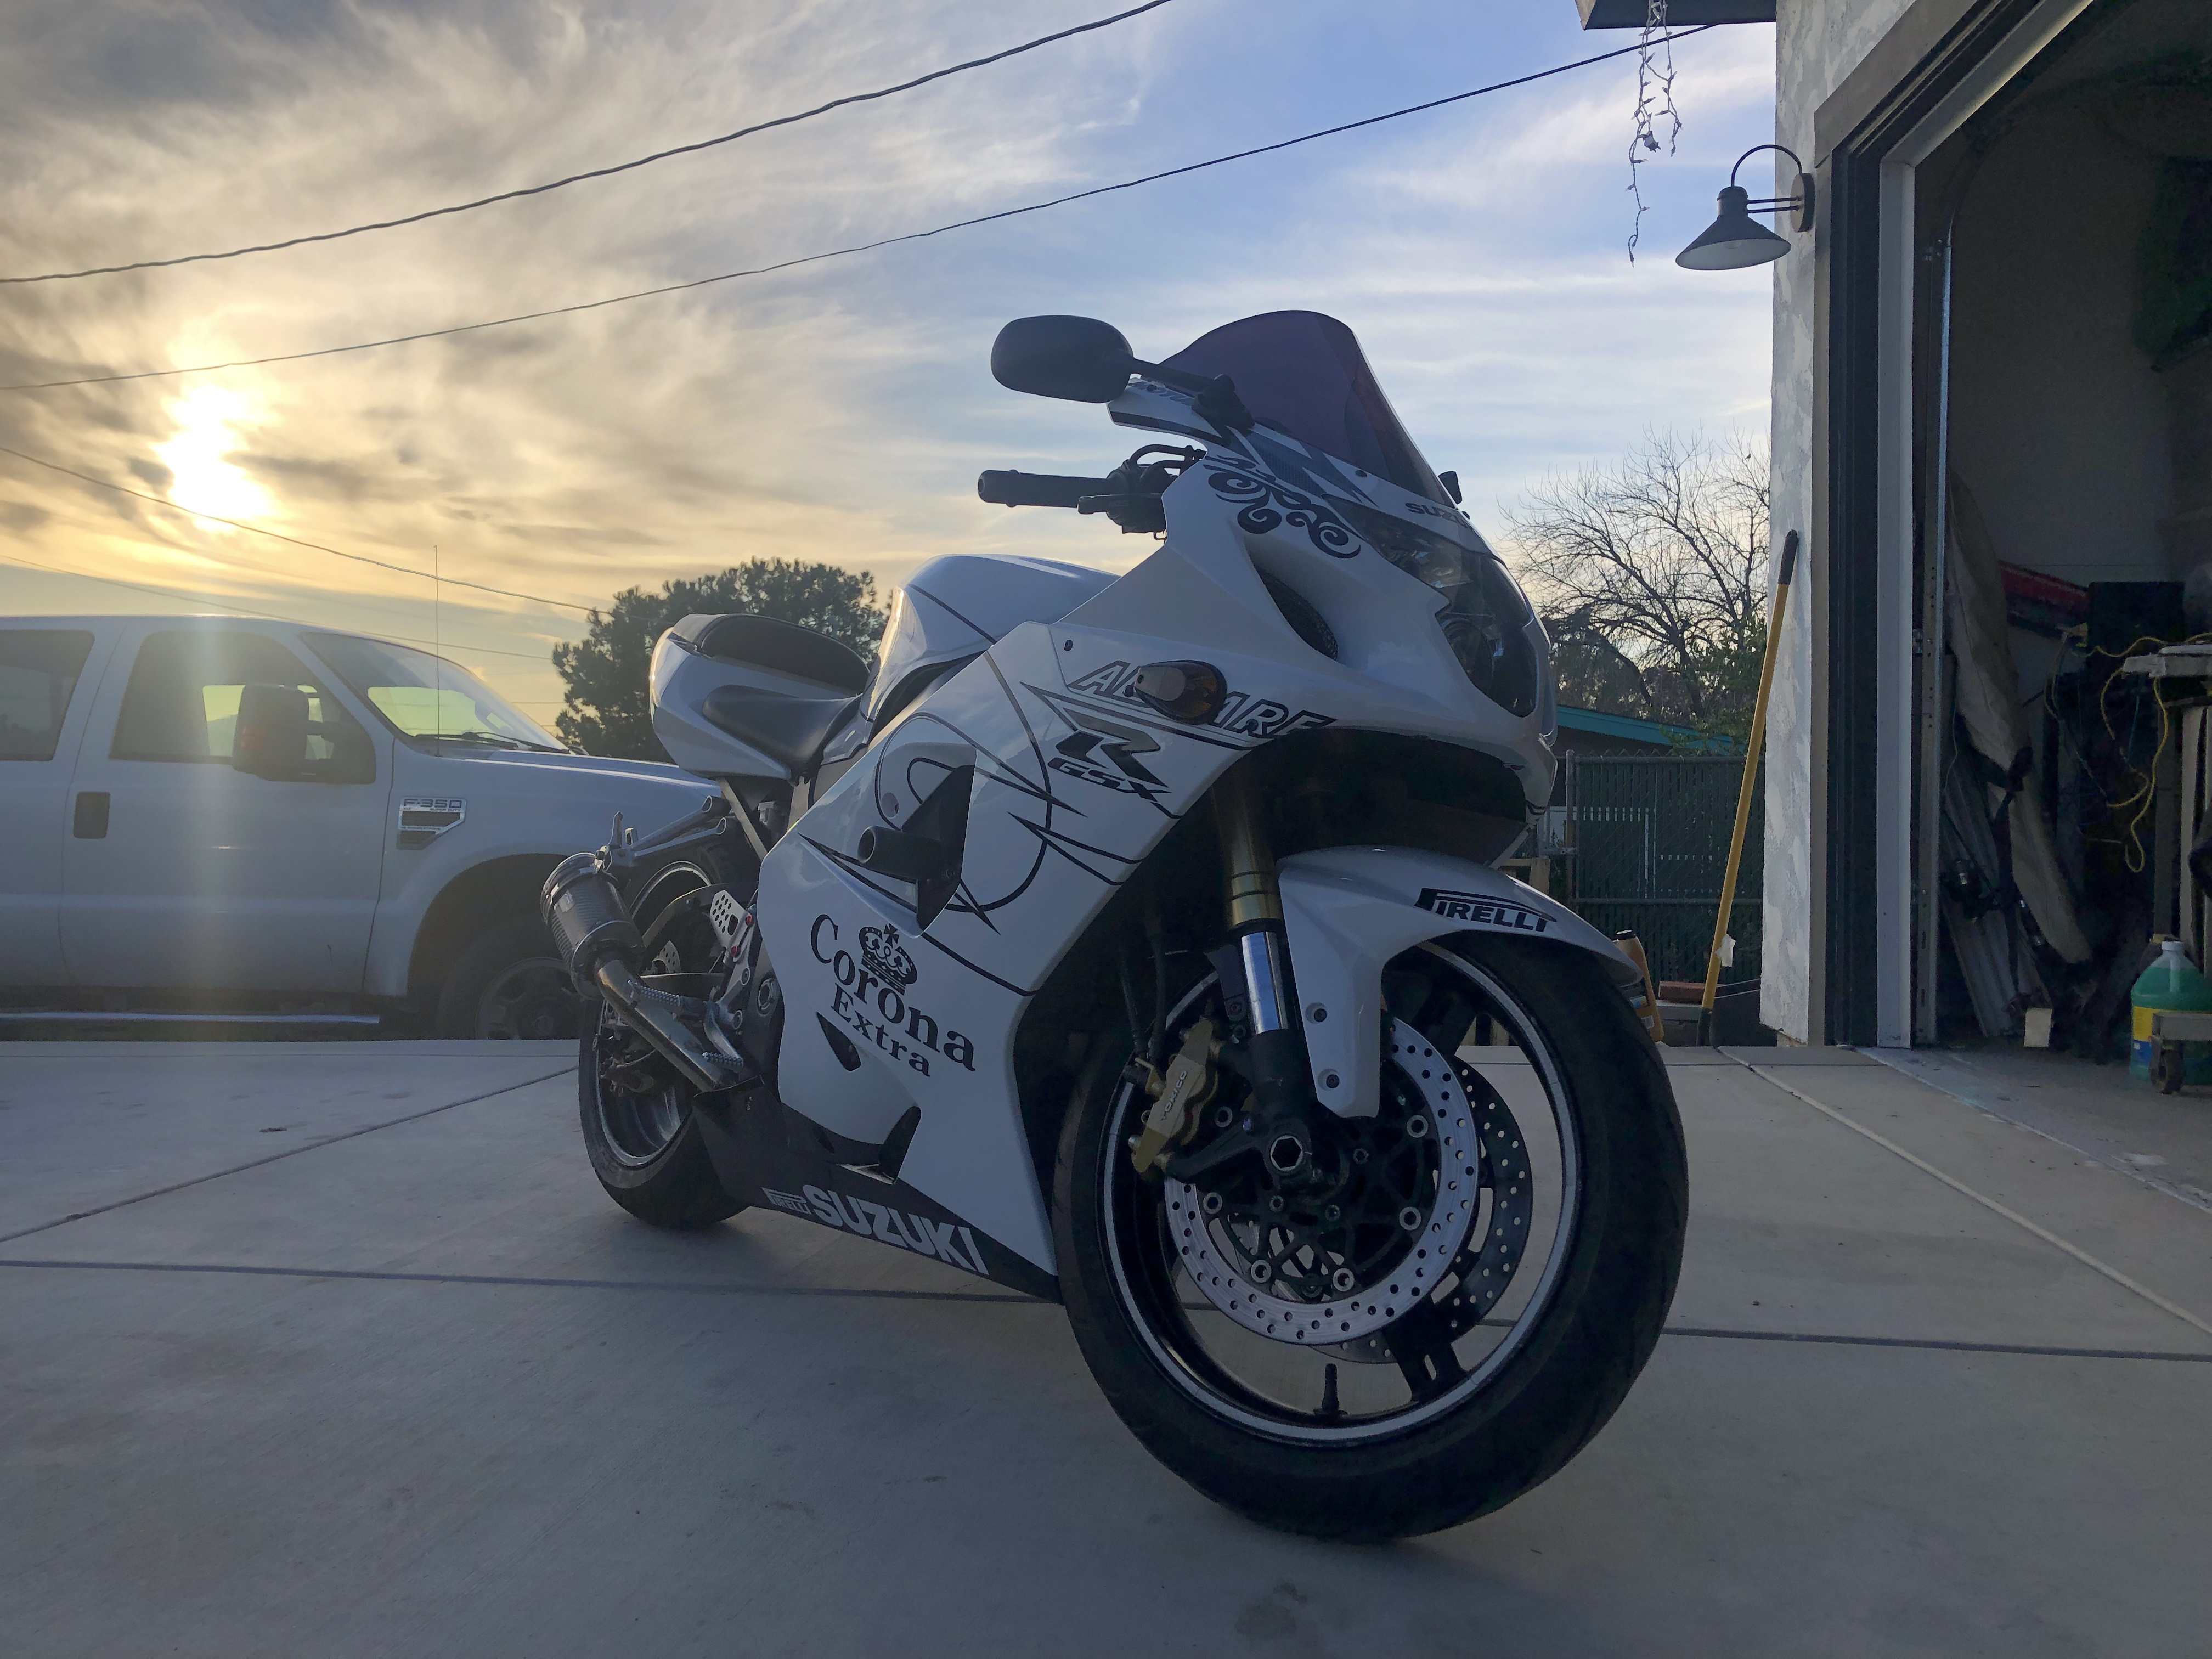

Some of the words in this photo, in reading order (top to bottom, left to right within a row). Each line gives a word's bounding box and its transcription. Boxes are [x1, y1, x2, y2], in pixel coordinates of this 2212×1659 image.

[404, 799, 462, 808] F-350
[1047, 757, 1172, 803] GSX
[1414, 887, 1558, 933] PIRELLI
[810, 913, 976, 1071] Corona
[831, 983, 931, 1077] Extra
[1160, 1070, 1188, 1121] TOKICO
[760, 1187, 812, 1215] PIRELLI
[802, 1184, 990, 1276] SUZUKI
